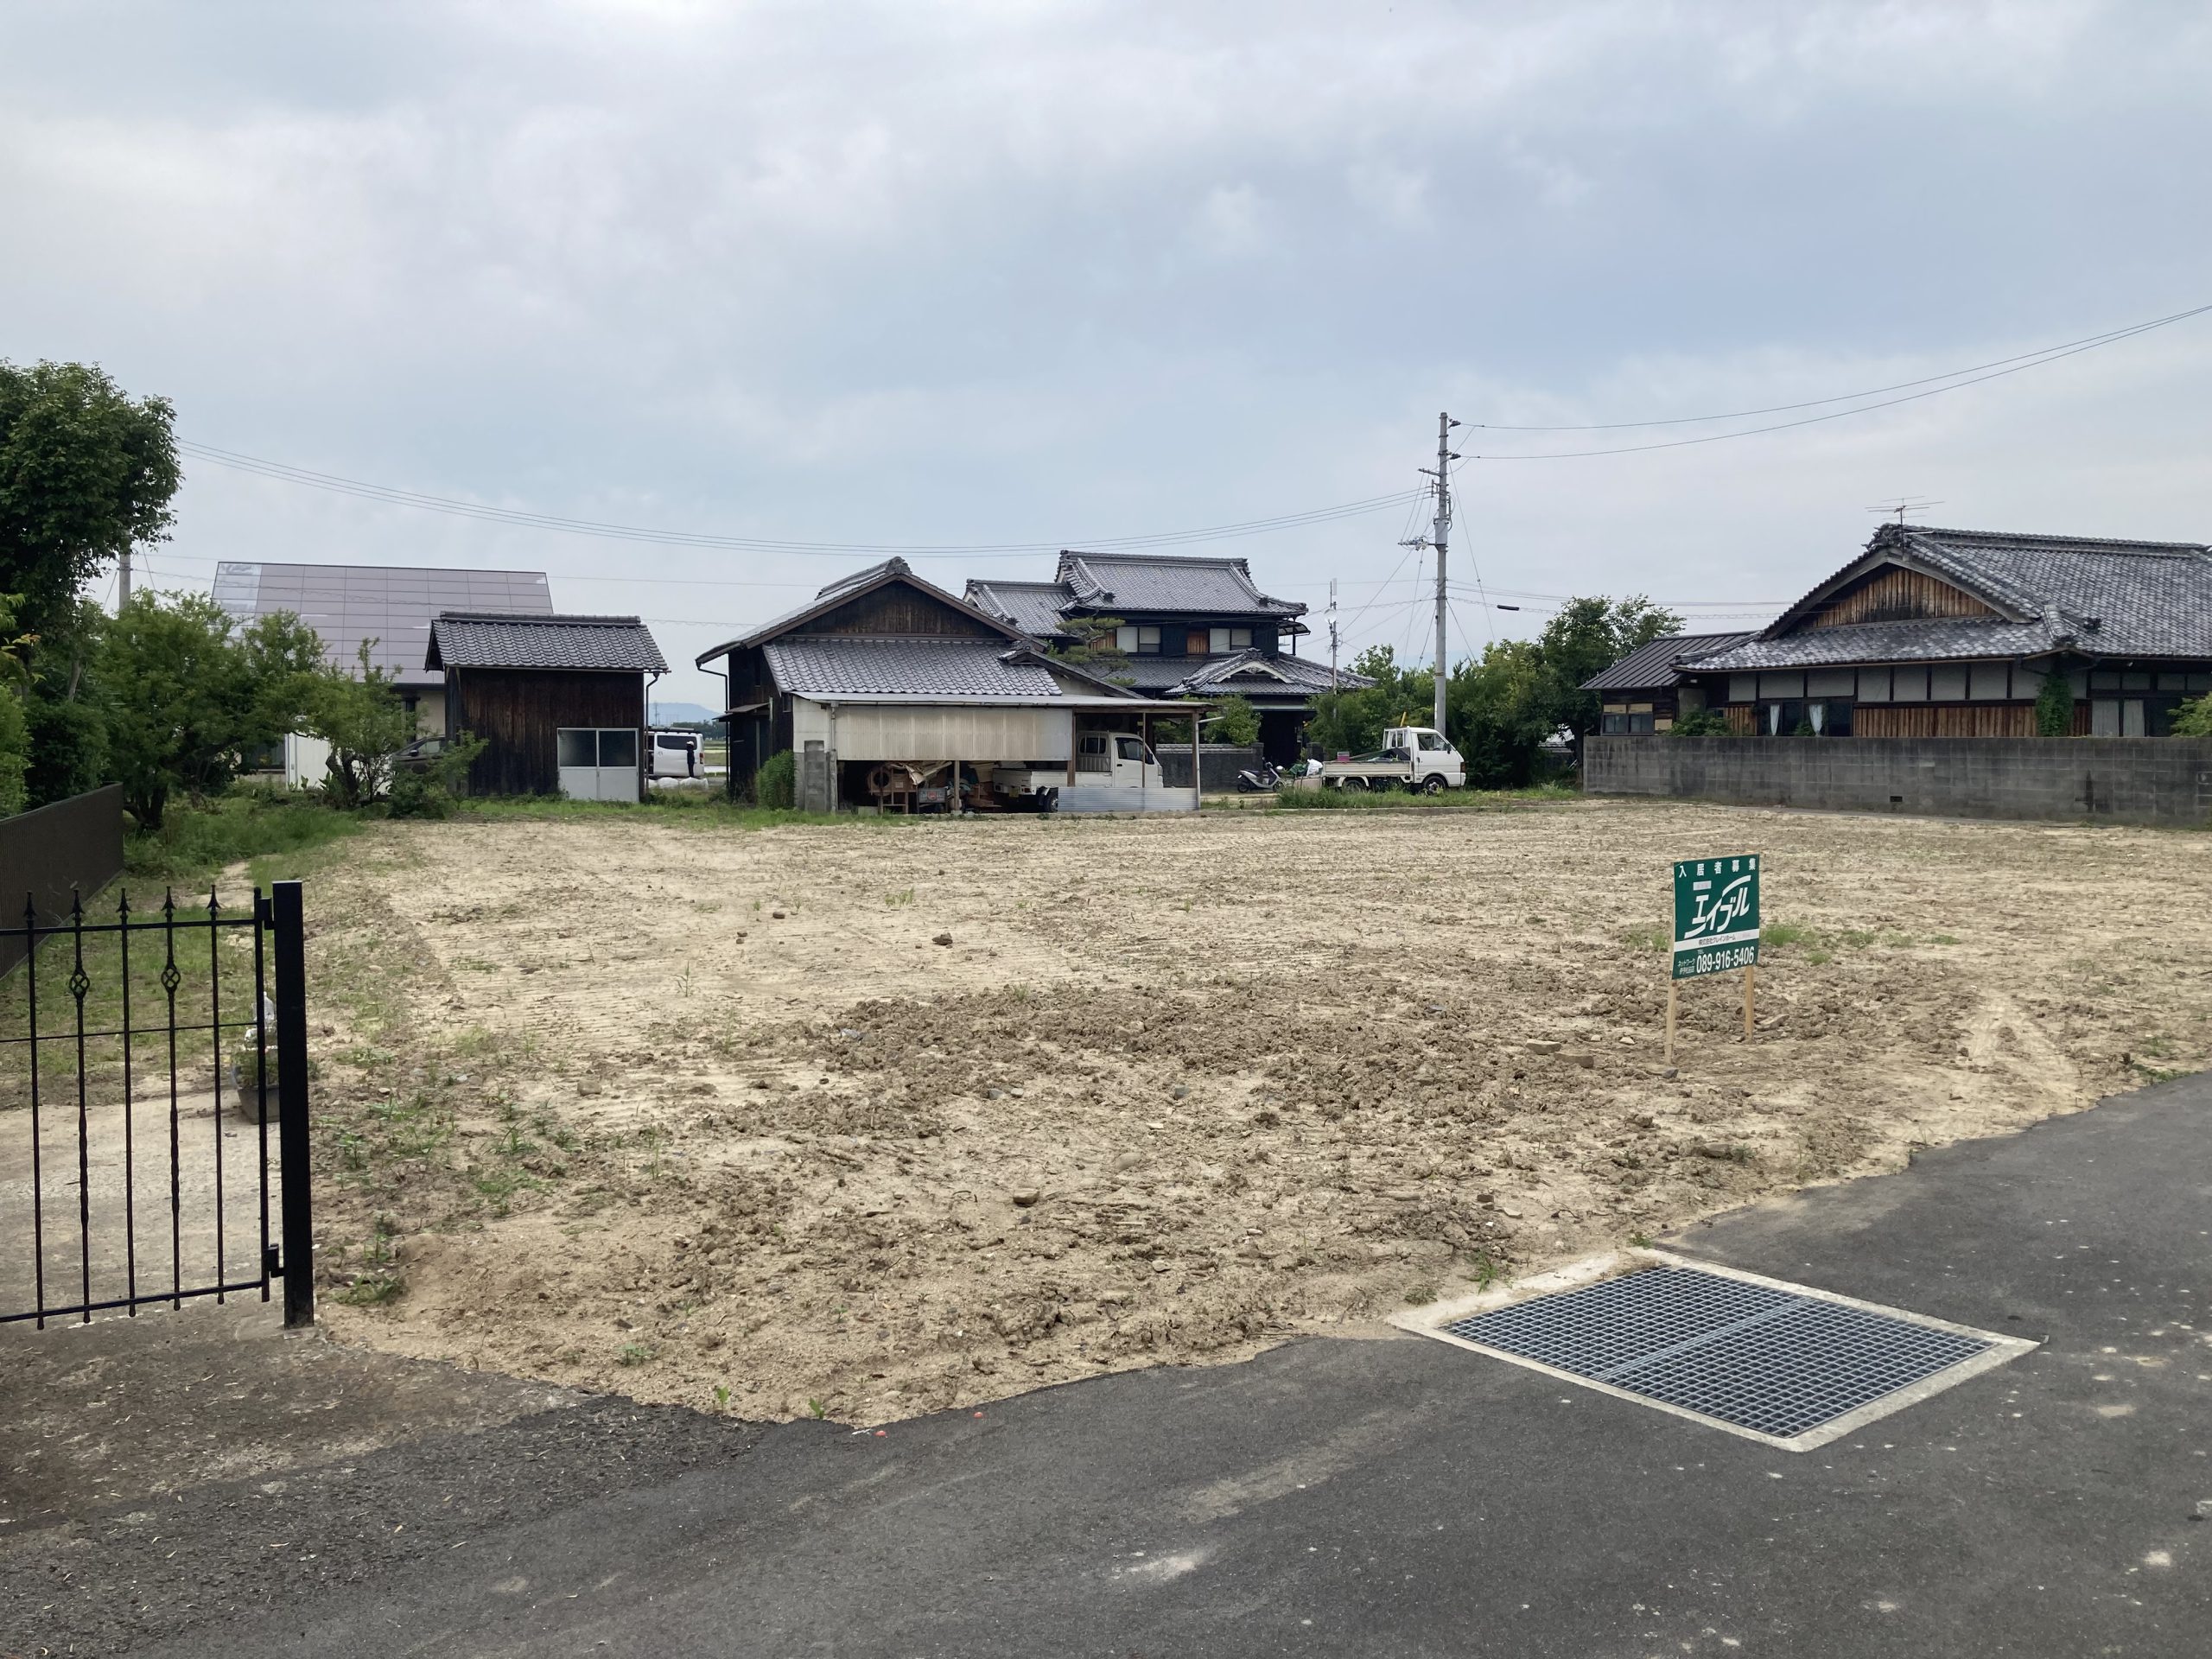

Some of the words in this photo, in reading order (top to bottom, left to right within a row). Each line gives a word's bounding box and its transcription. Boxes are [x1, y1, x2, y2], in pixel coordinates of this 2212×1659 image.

[1679, 858, 1756, 878] 入居者募集
[1689, 887, 1751, 933] エイブル
[1696, 946, 1755, 974] 089-916-5406
